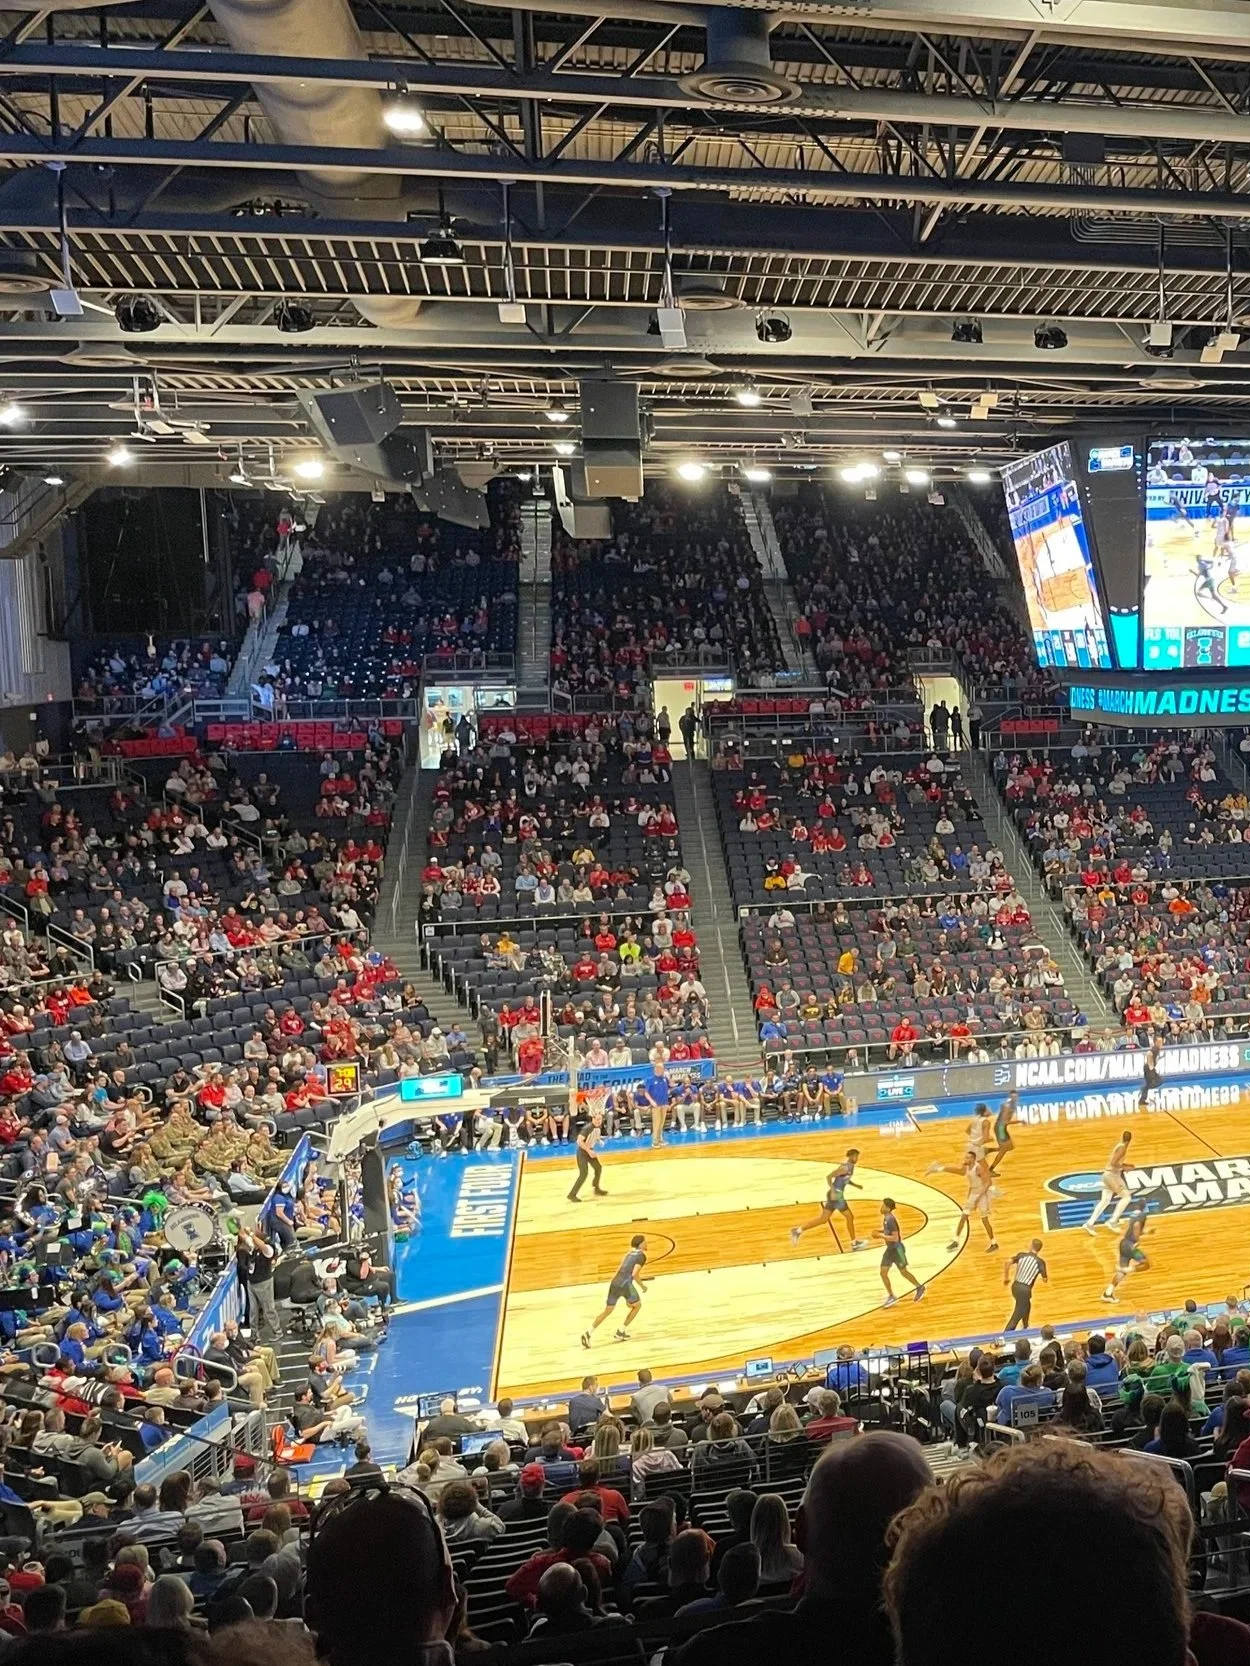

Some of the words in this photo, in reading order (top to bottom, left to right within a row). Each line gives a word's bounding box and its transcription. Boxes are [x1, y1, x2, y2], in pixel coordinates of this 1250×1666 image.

[334, 1078, 352, 1090] 29
[547, 1075, 564, 1083] THE
[459, 1164, 513, 1197] FOUR
[1068, 1181, 1107, 1191] NCA
[449, 1198, 508, 1237] FIRST
[1020, 1410, 1036, 1419] 105
